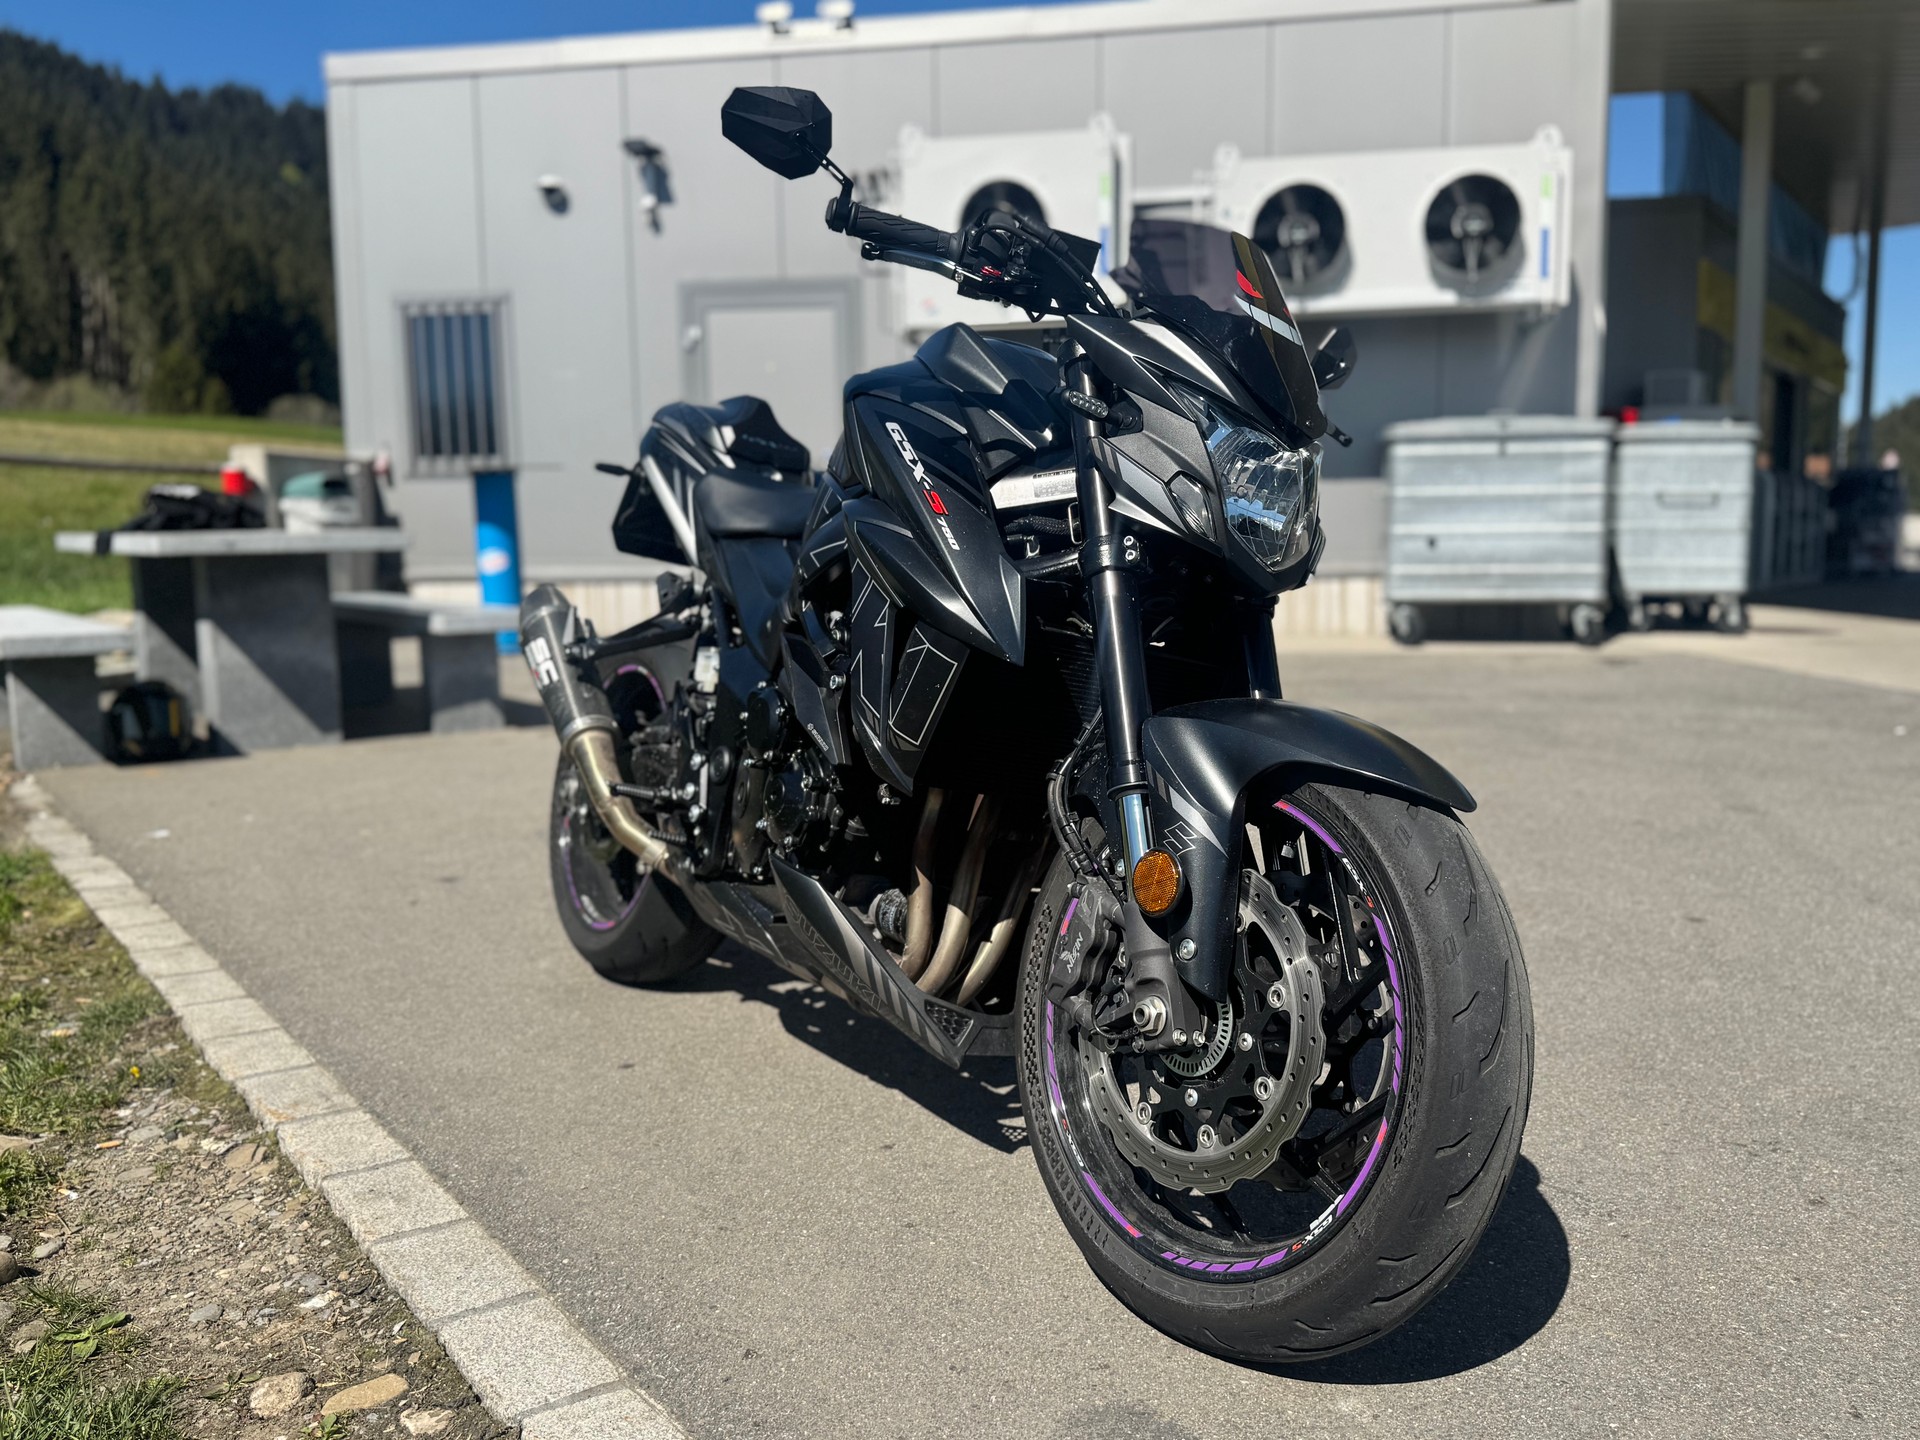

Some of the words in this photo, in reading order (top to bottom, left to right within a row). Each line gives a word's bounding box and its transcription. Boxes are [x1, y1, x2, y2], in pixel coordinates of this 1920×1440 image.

[886, 422, 949, 515] GSX-S
[936, 517, 960, 551] 750
[1341, 857, 1375, 908] GSX-S
[784, 894, 882, 1012] SUZUKI
[1291, 1215, 1332, 1252] GSX-S
